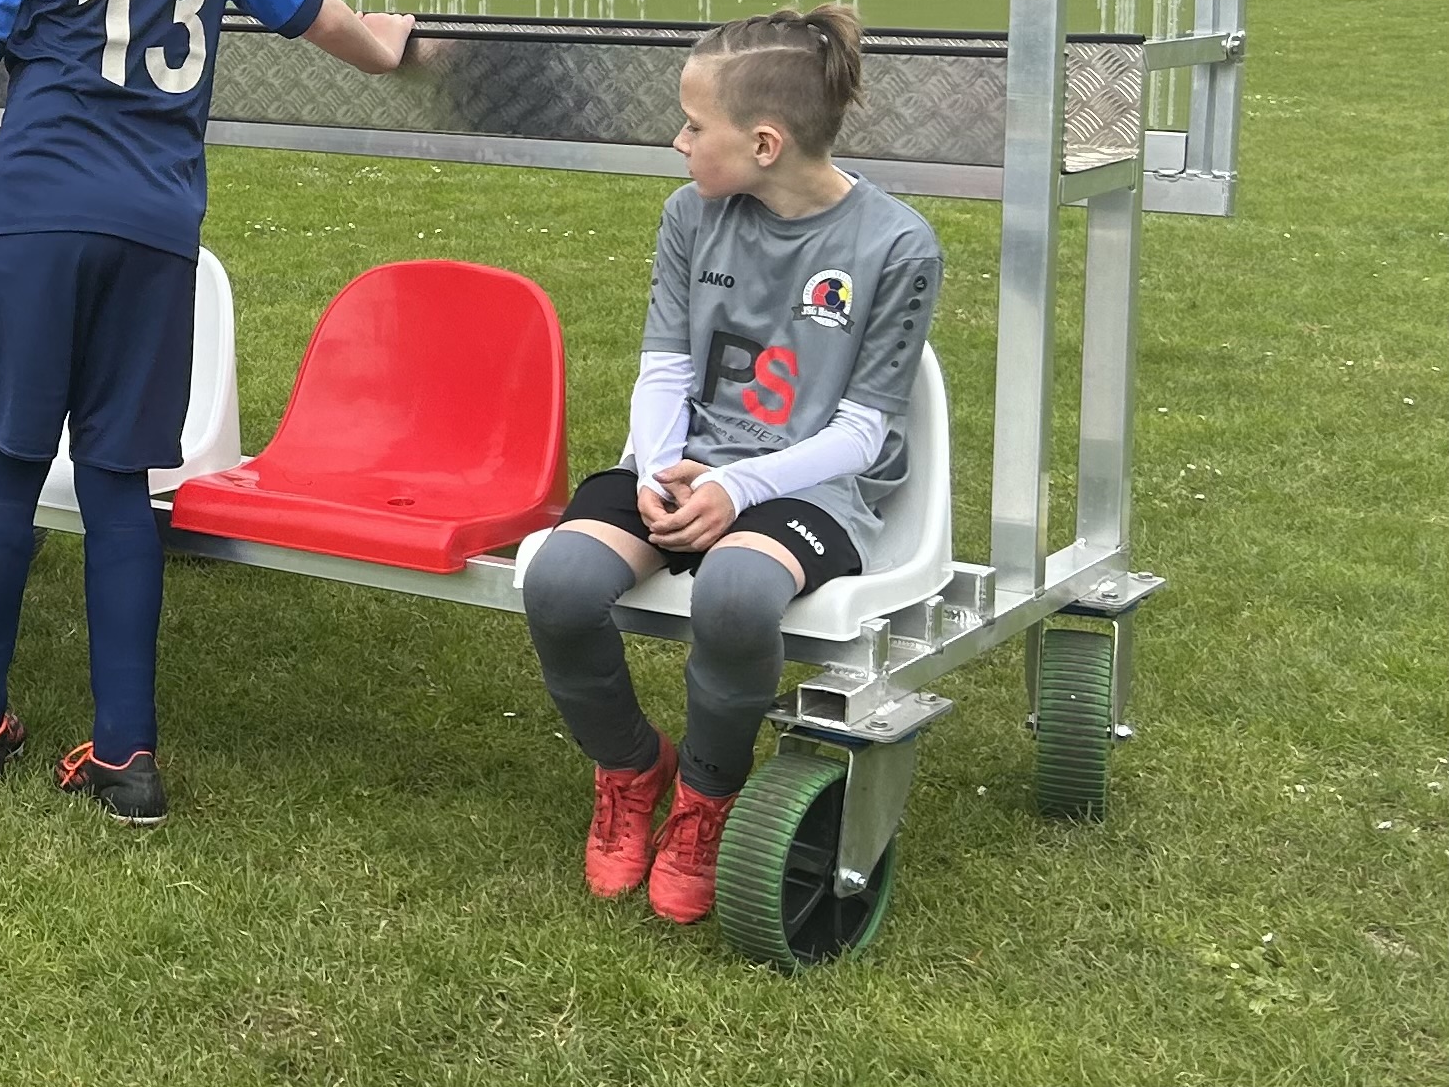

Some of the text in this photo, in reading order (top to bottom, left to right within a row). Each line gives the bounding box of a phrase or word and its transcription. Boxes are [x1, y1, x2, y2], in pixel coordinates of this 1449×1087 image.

[698, 270, 735, 289] JAKO
[701, 330, 800, 425] PS
[786, 517, 826, 557] JAKO
